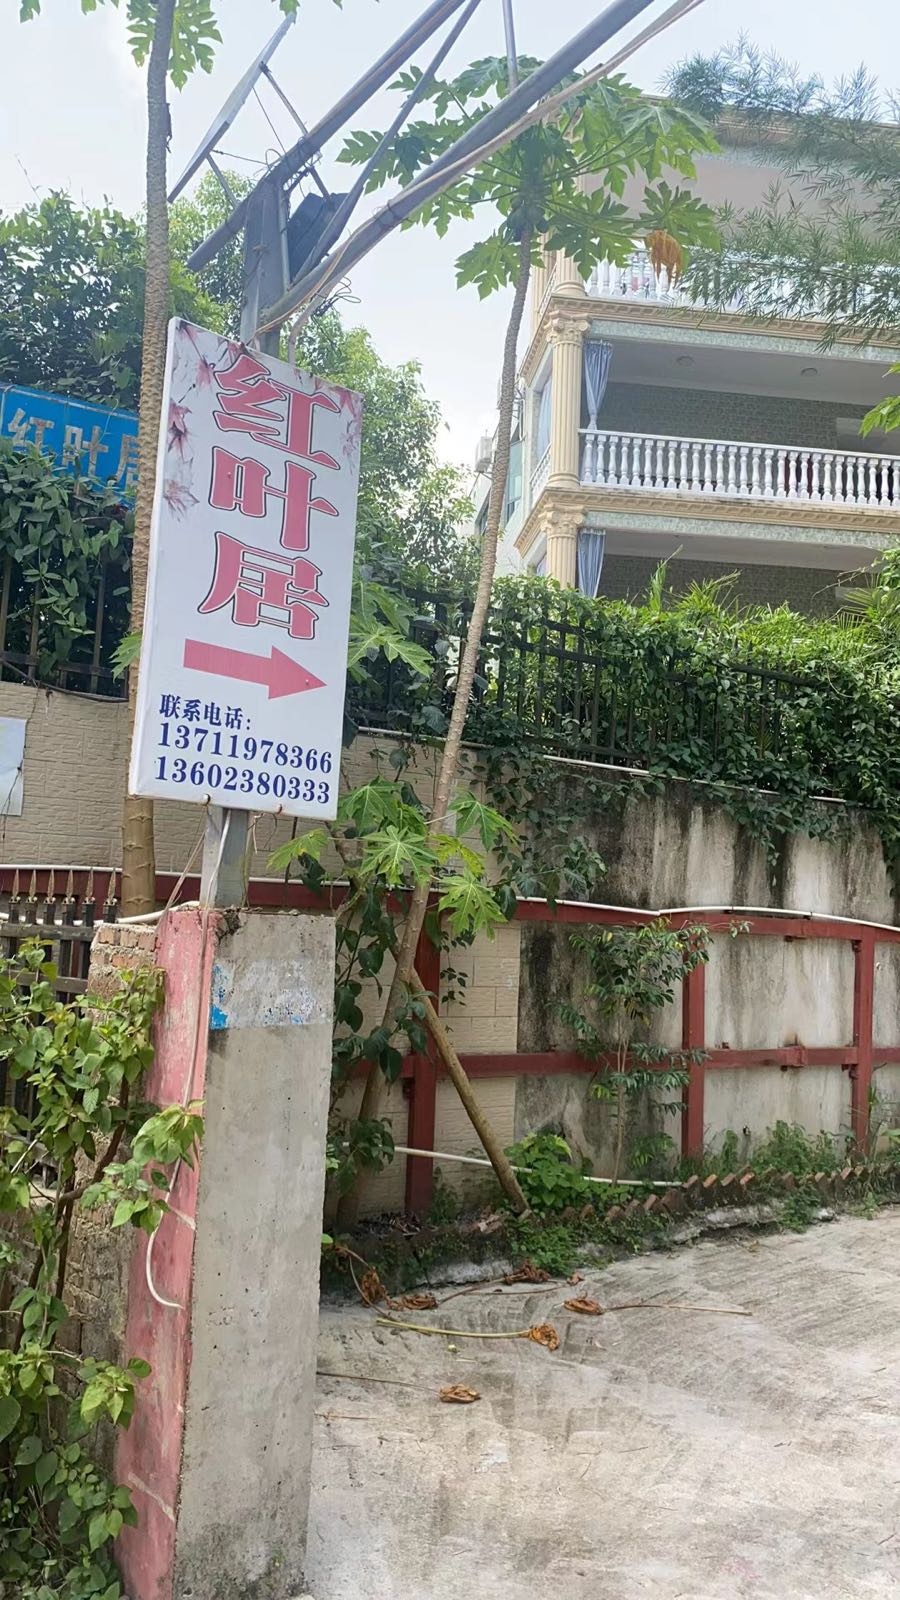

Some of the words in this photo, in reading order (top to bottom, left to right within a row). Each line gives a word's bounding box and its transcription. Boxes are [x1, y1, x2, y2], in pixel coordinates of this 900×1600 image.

[196, 353, 341, 640] 红叶居
[157, 722, 332, 774] 13711978366
[154, 756, 330, 804] 13602380333
